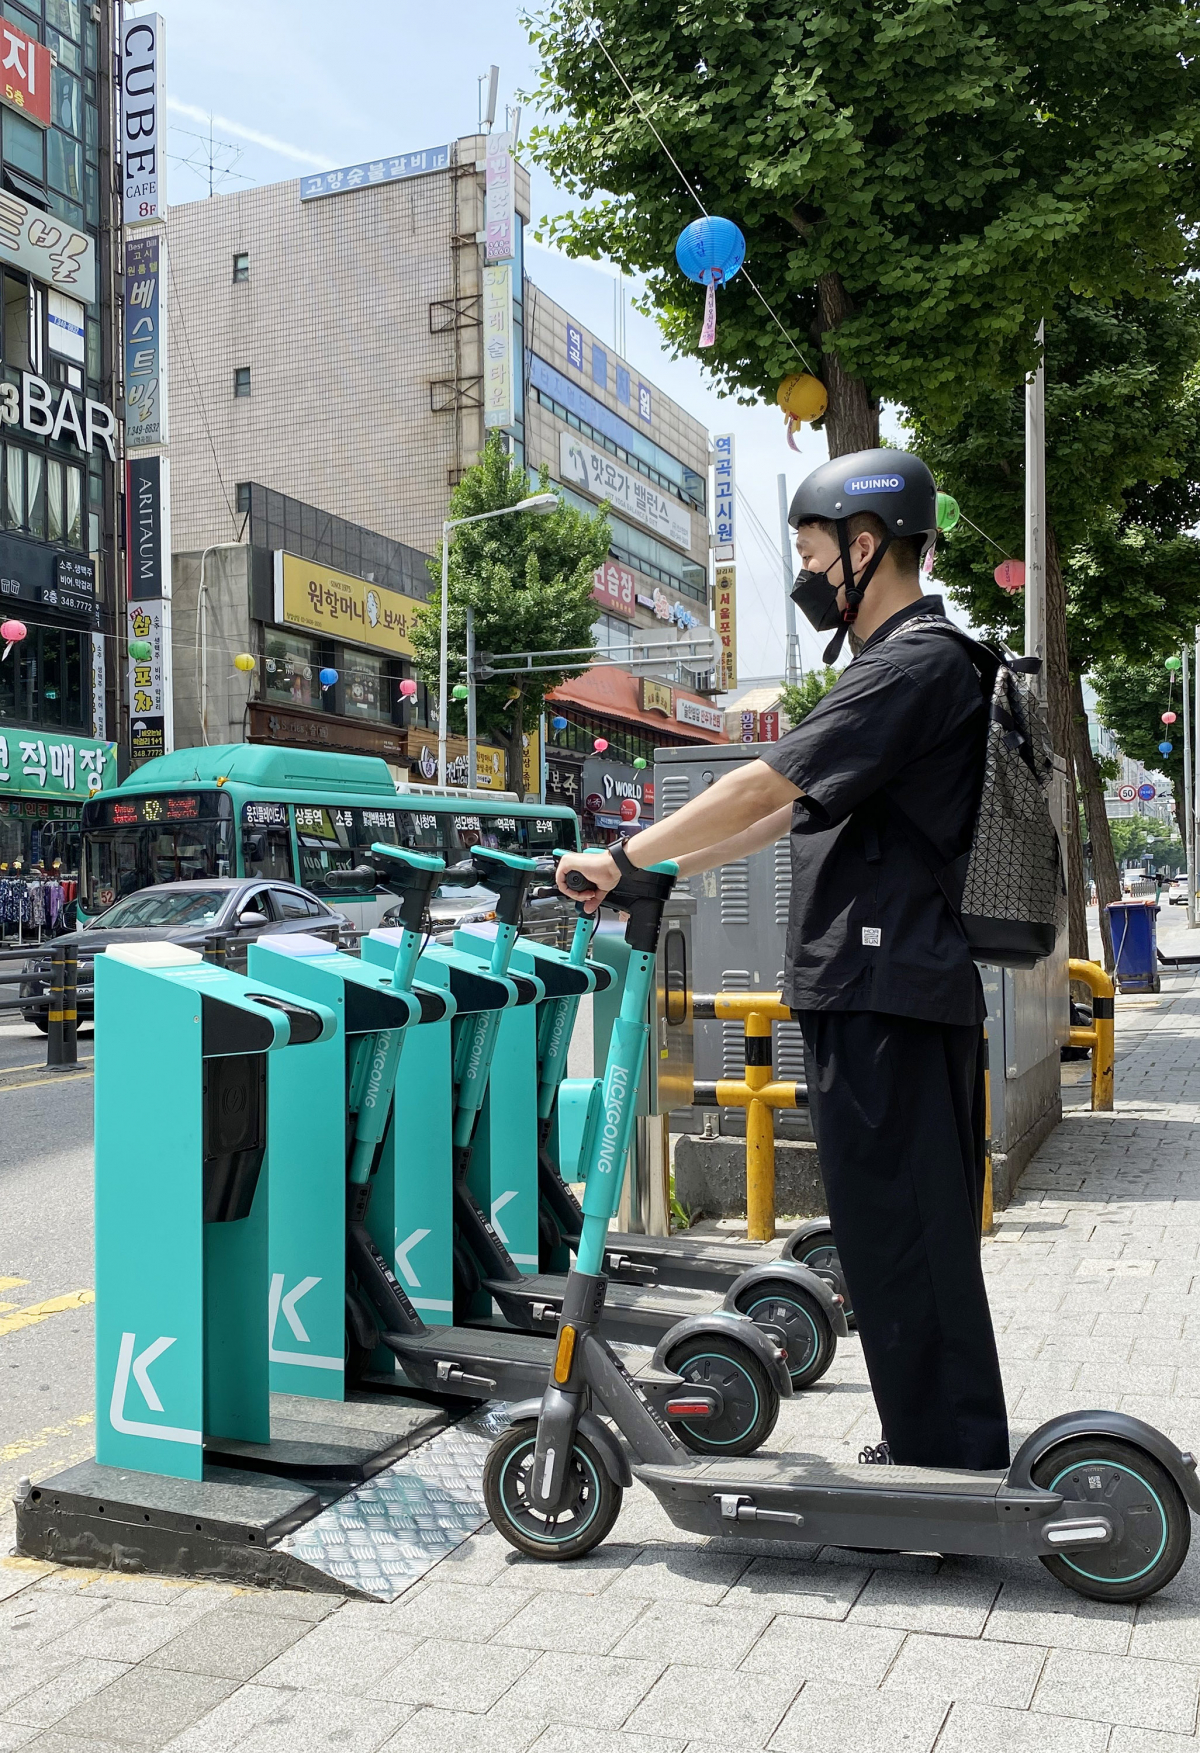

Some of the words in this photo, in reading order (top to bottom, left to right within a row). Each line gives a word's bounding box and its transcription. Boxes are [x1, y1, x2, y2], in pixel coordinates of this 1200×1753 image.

[2, 28, 35, 95] 지
[5, 84, 25, 108] 5층
[124, 24, 156, 181] CUBE
[126, 181, 156, 199] CAFE
[138, 202, 156, 217] 8F
[129, 278, 159, 423] 베스트빌
[22, 371, 117, 463] BAR
[591, 454, 631, 501] 핫요가
[851, 478, 899, 491] HUINNO
[715, 436, 733, 543] 역곡고시원
[138, 476, 154, 579] ARITAUM
[43, 589, 58, 604] 2층
[60, 596, 93, 612] 348.7772
[308, 580, 365, 625] 원할머니
[133, 614, 153, 713] 삼포차
[150, 737, 163, 745] 1+1
[133, 749, 163, 758] 348.7772
[19, 739, 107, 791] 직매장
[614, 780, 642, 800] WORLD
[1122, 789, 1133, 798] 50
[145, 800, 160, 821] 52
[246, 805, 287, 824] 웅진플레이도시
[295, 808, 324, 826] 상동역
[335, 810, 354, 828] 소풍
[371, 811, 396, 828] 백화점
[415, 814, 437, 829] 시청역
[454, 816, 481, 831] 성모병원
[497, 818, 516, 832] 역곡역
[536, 820, 553, 834] 온수역
[100, 891, 114, 904] 52
[597, 1063, 629, 1175] KICKGOING
